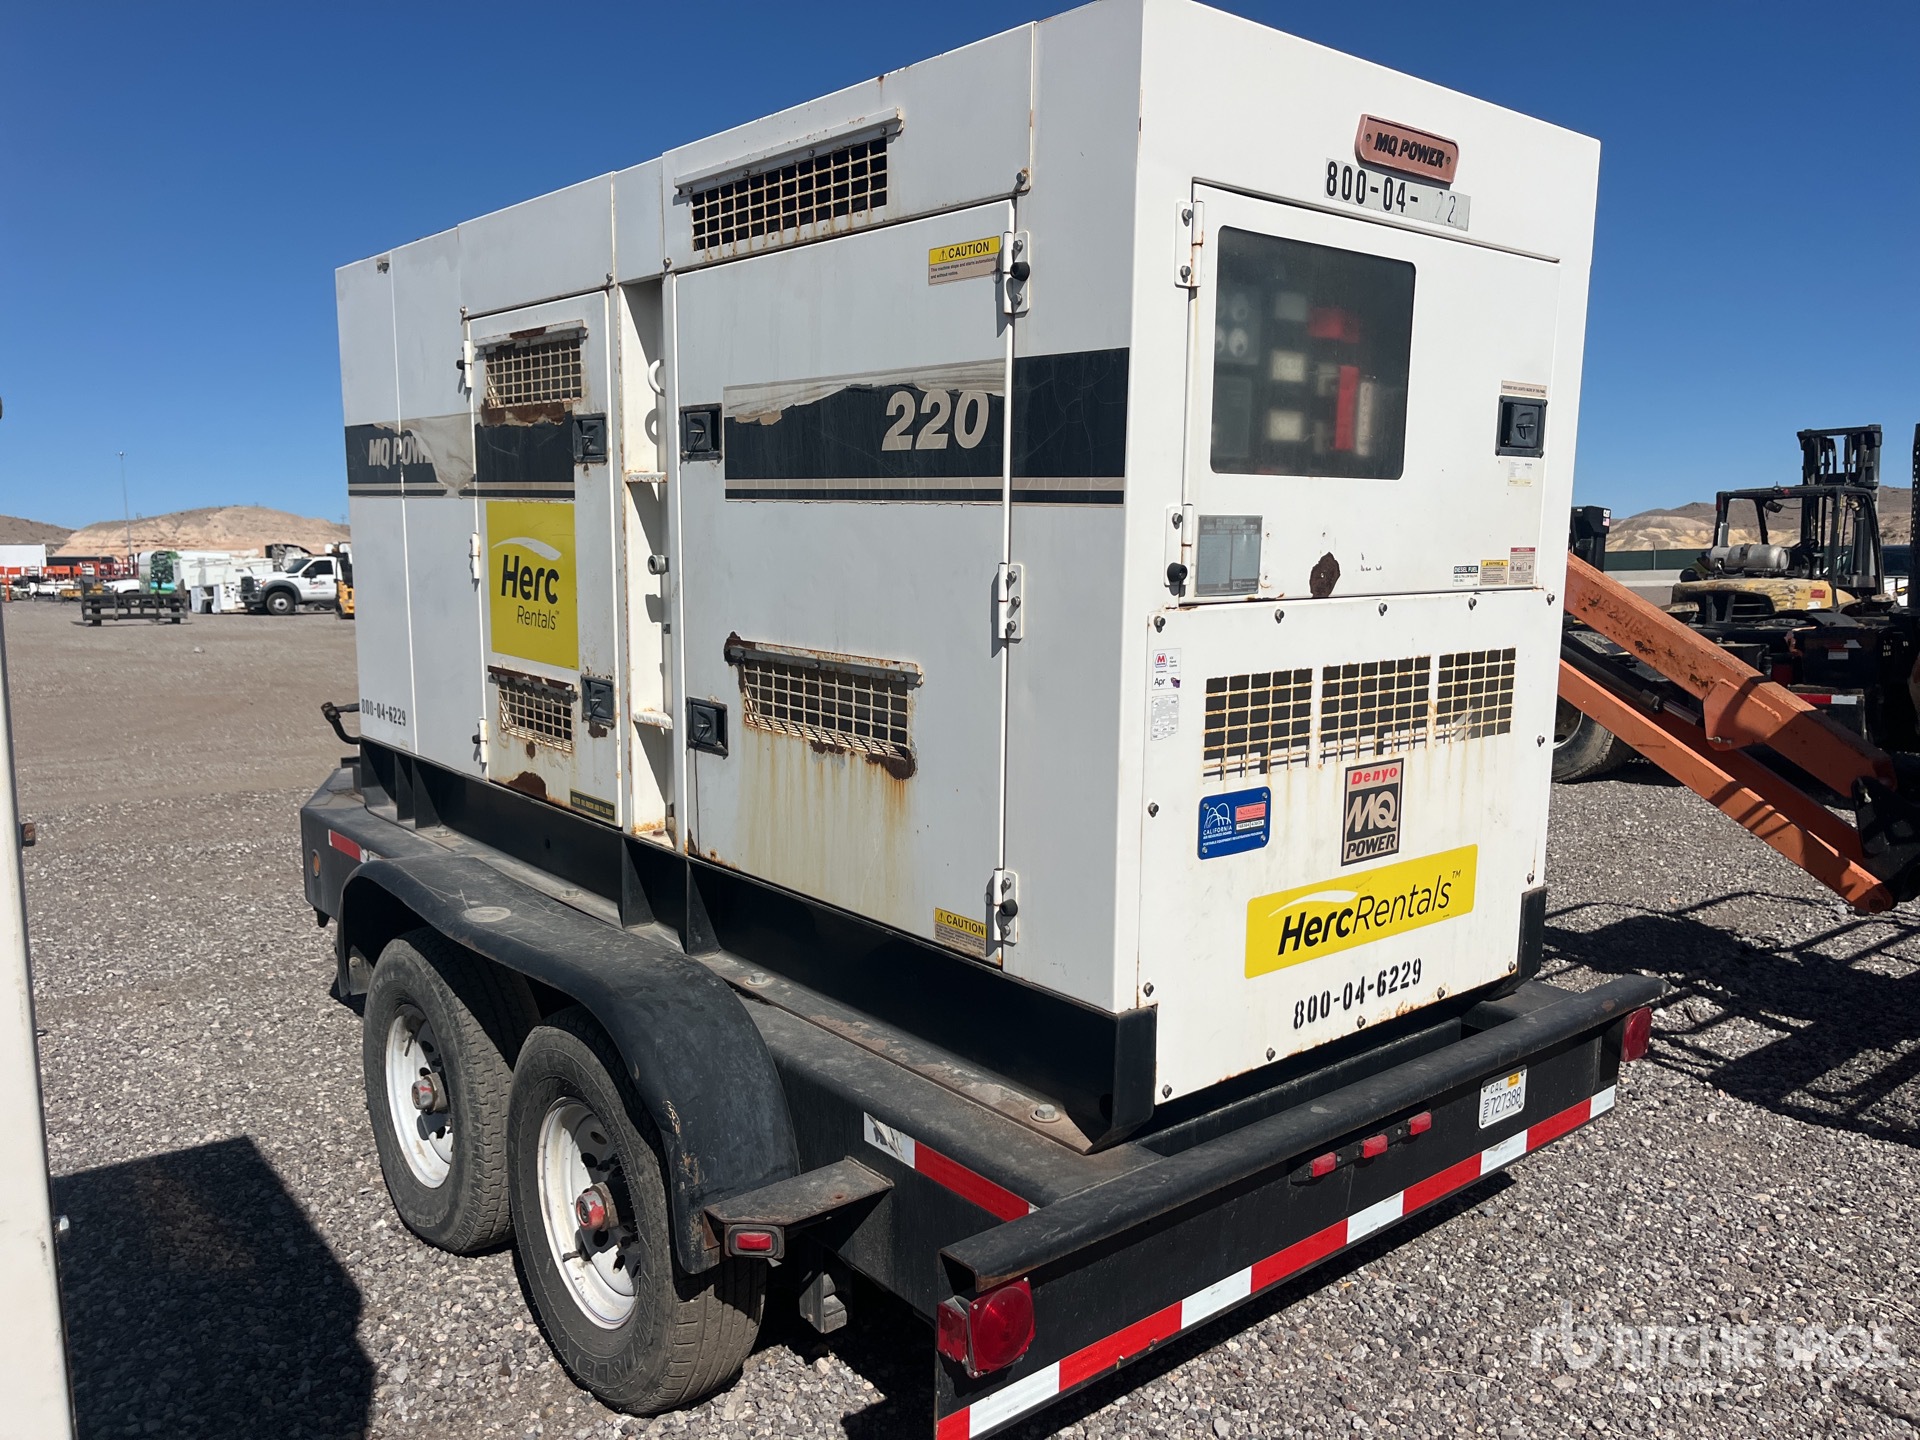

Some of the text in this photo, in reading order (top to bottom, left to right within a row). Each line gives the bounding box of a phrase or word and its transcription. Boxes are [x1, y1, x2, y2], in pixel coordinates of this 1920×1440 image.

[1373, 132, 1446, 169] MQ POWER
[948, 241, 990, 258] CAUTION
[881, 388, 990, 451] 220
[368, 437, 391, 470] MQ
[501, 554, 560, 605] Herc
[516, 605, 557, 631] Rentals
[1154, 677, 1166, 687] Apr
[361, 698, 407, 727] 800-04-6229
[1351, 767, 1398, 785] Denyo
[1346, 790, 1397, 833] MQ
[1203, 825, 1233, 836] CALIFORNIA
[1345, 833, 1396, 860] POWER
[946, 914, 984, 936] CAUTION
[1293, 957, 1422, 1030] 800-04-6229
[1490, 1082, 1503, 1094] CAL
[1490, 1086, 1522, 1116] 727388
